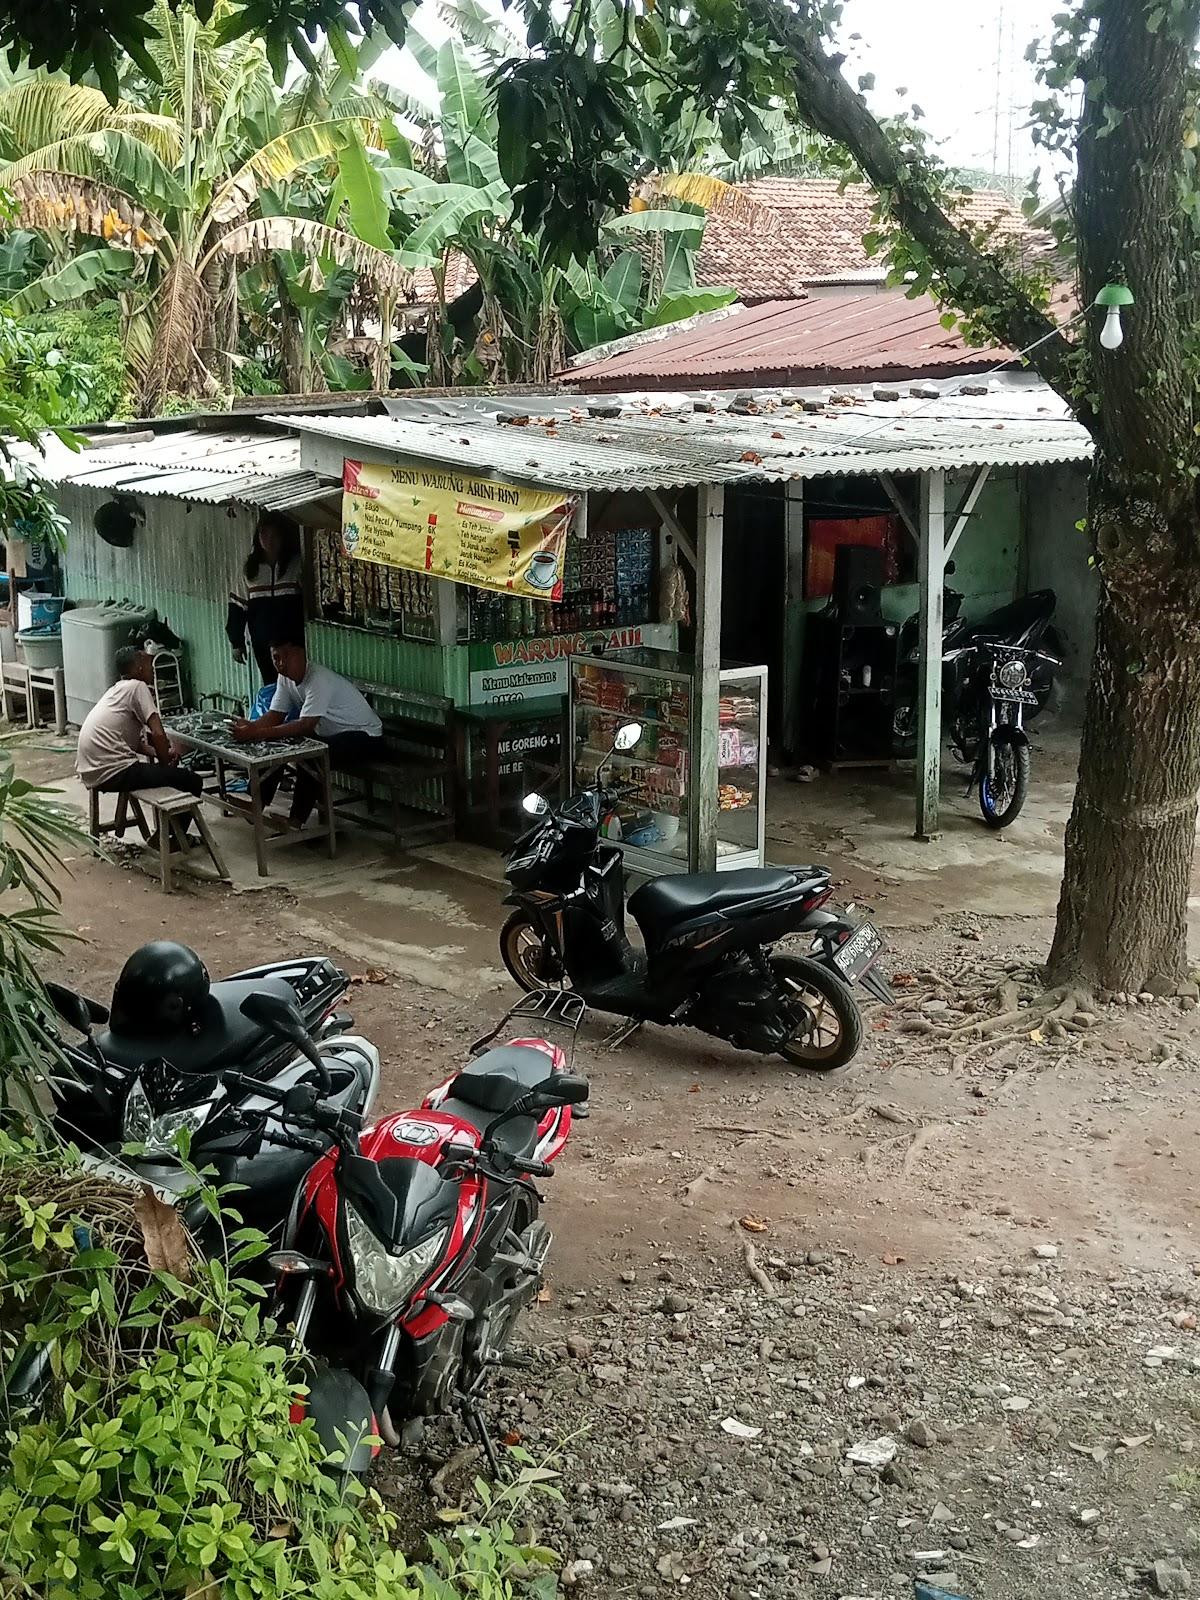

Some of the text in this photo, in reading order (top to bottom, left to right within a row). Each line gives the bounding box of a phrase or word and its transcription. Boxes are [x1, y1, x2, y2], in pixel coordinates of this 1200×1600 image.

[391, 469, 419, 485] MENU
[422, 473, 464, 493] WARUNG
[395, 519, 422, 533] Tumpang
[493, 627, 643, 667] WARUNG AUL
[482, 676, 509, 691] Menu
[510, 672, 552, 688] Makanan
